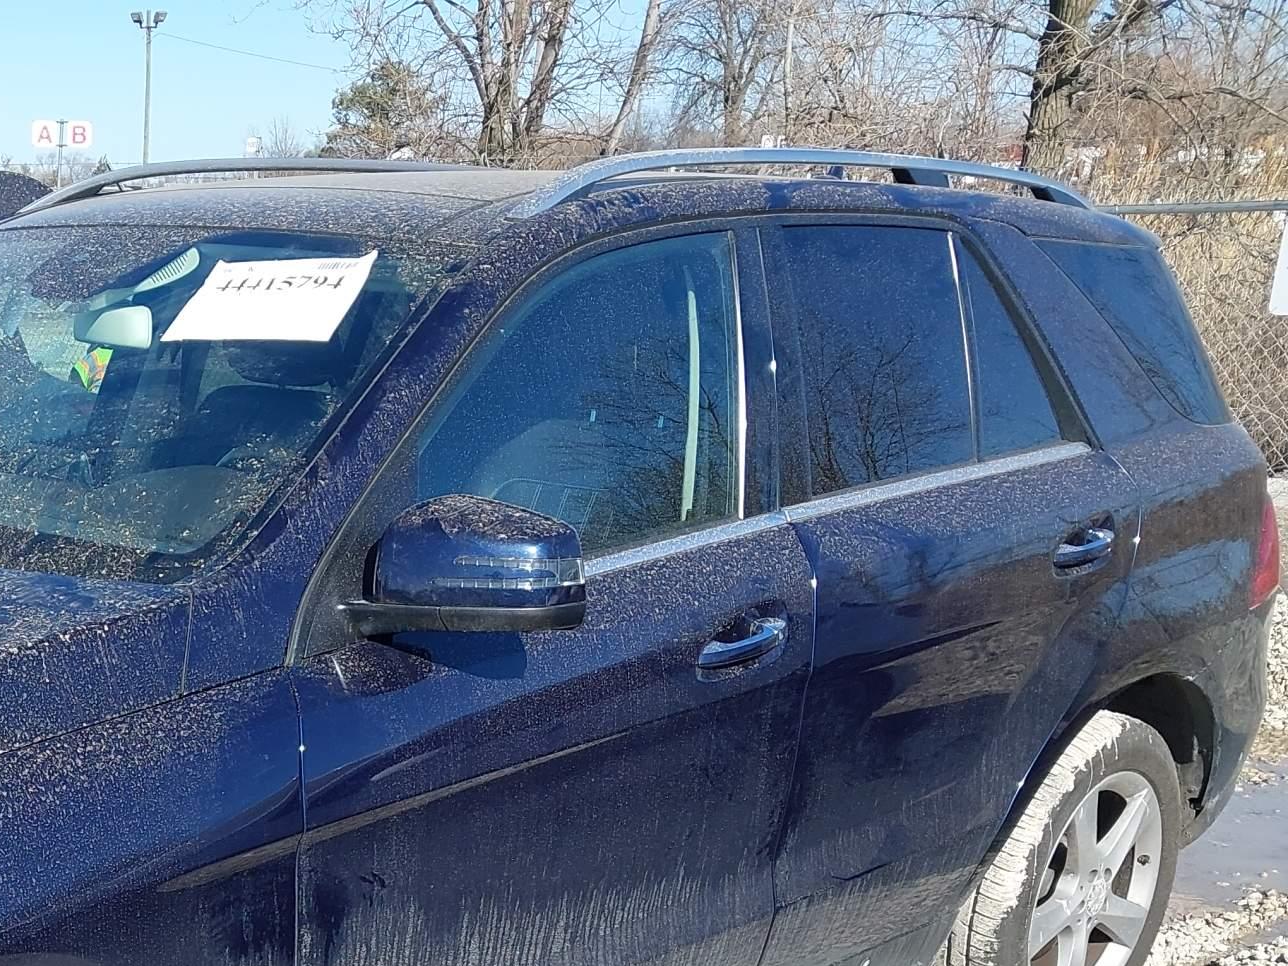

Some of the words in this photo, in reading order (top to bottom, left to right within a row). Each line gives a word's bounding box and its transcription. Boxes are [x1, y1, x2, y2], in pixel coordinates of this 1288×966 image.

[37, 125, 53, 144] A
[72, 125, 87, 144] B
[215, 274, 346, 293] 44415794
